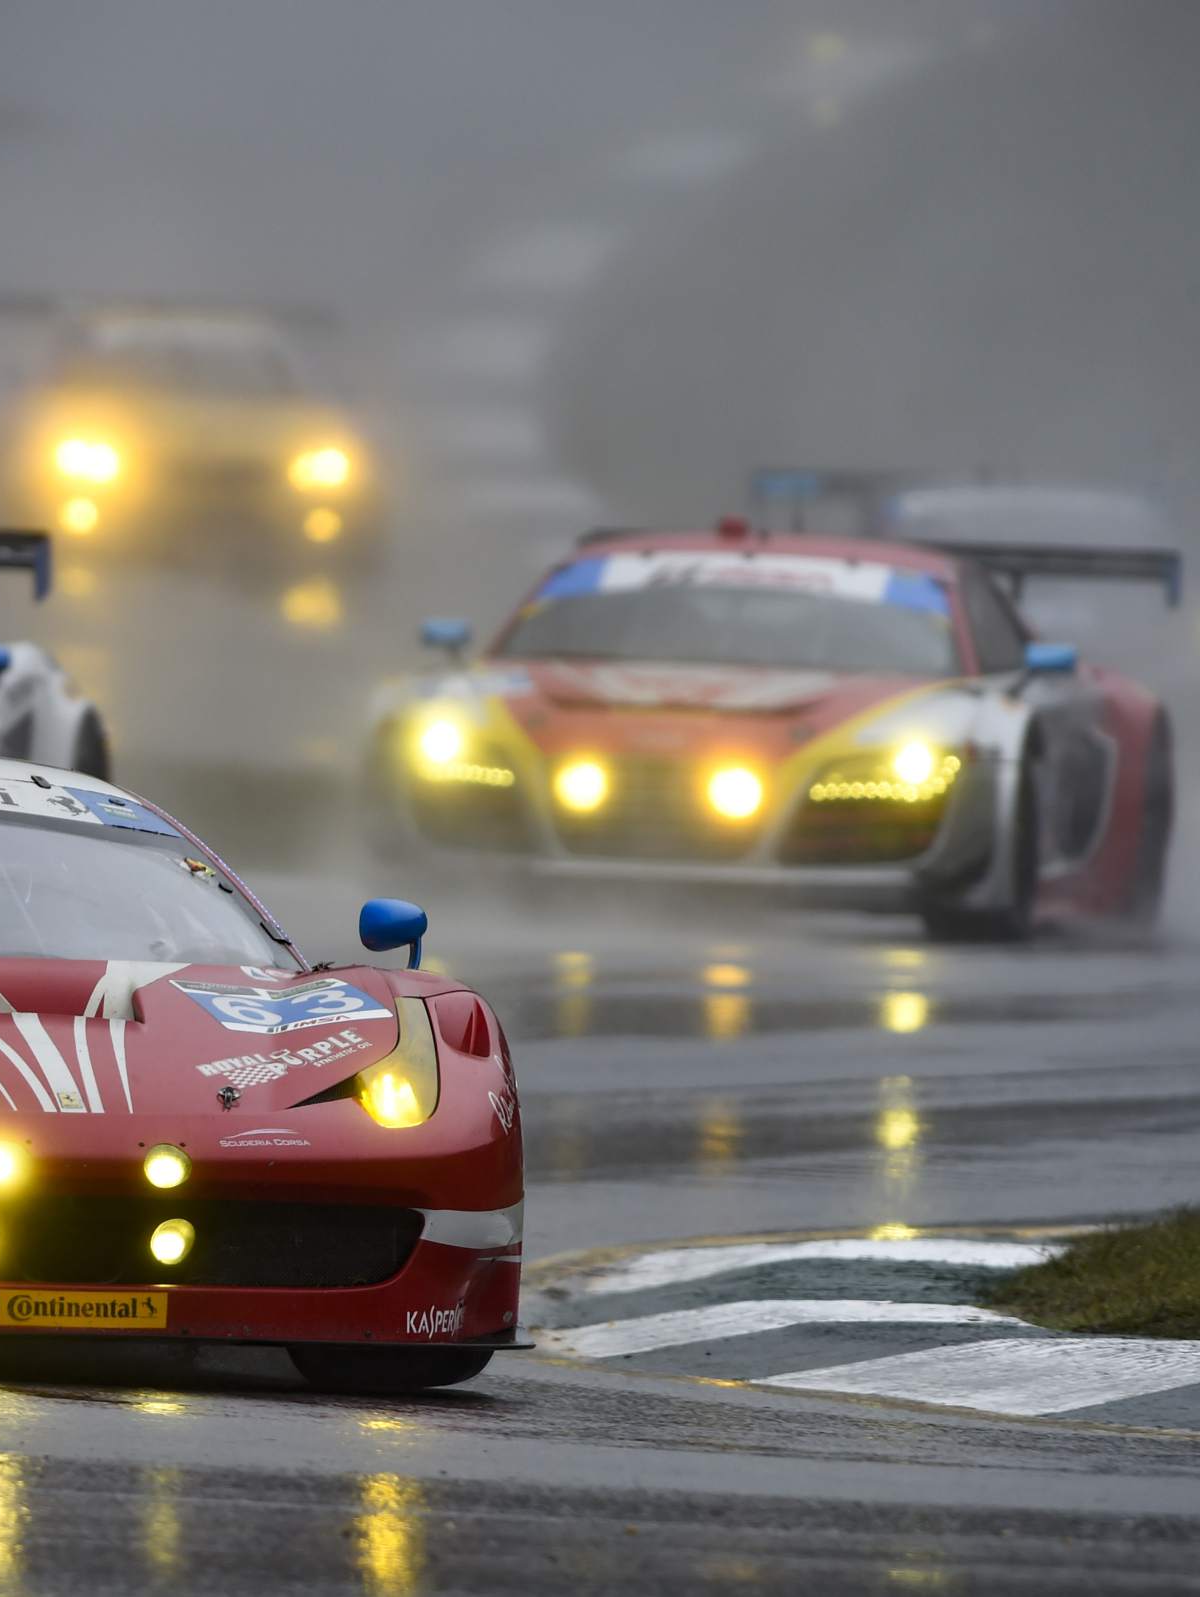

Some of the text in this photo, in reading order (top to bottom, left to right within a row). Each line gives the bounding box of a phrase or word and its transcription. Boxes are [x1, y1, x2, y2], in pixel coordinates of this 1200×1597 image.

[211, 990, 365, 1026] 63
[293, 1014, 350, 1029] IMSA
[7, 1294, 137, 1321] Continental
